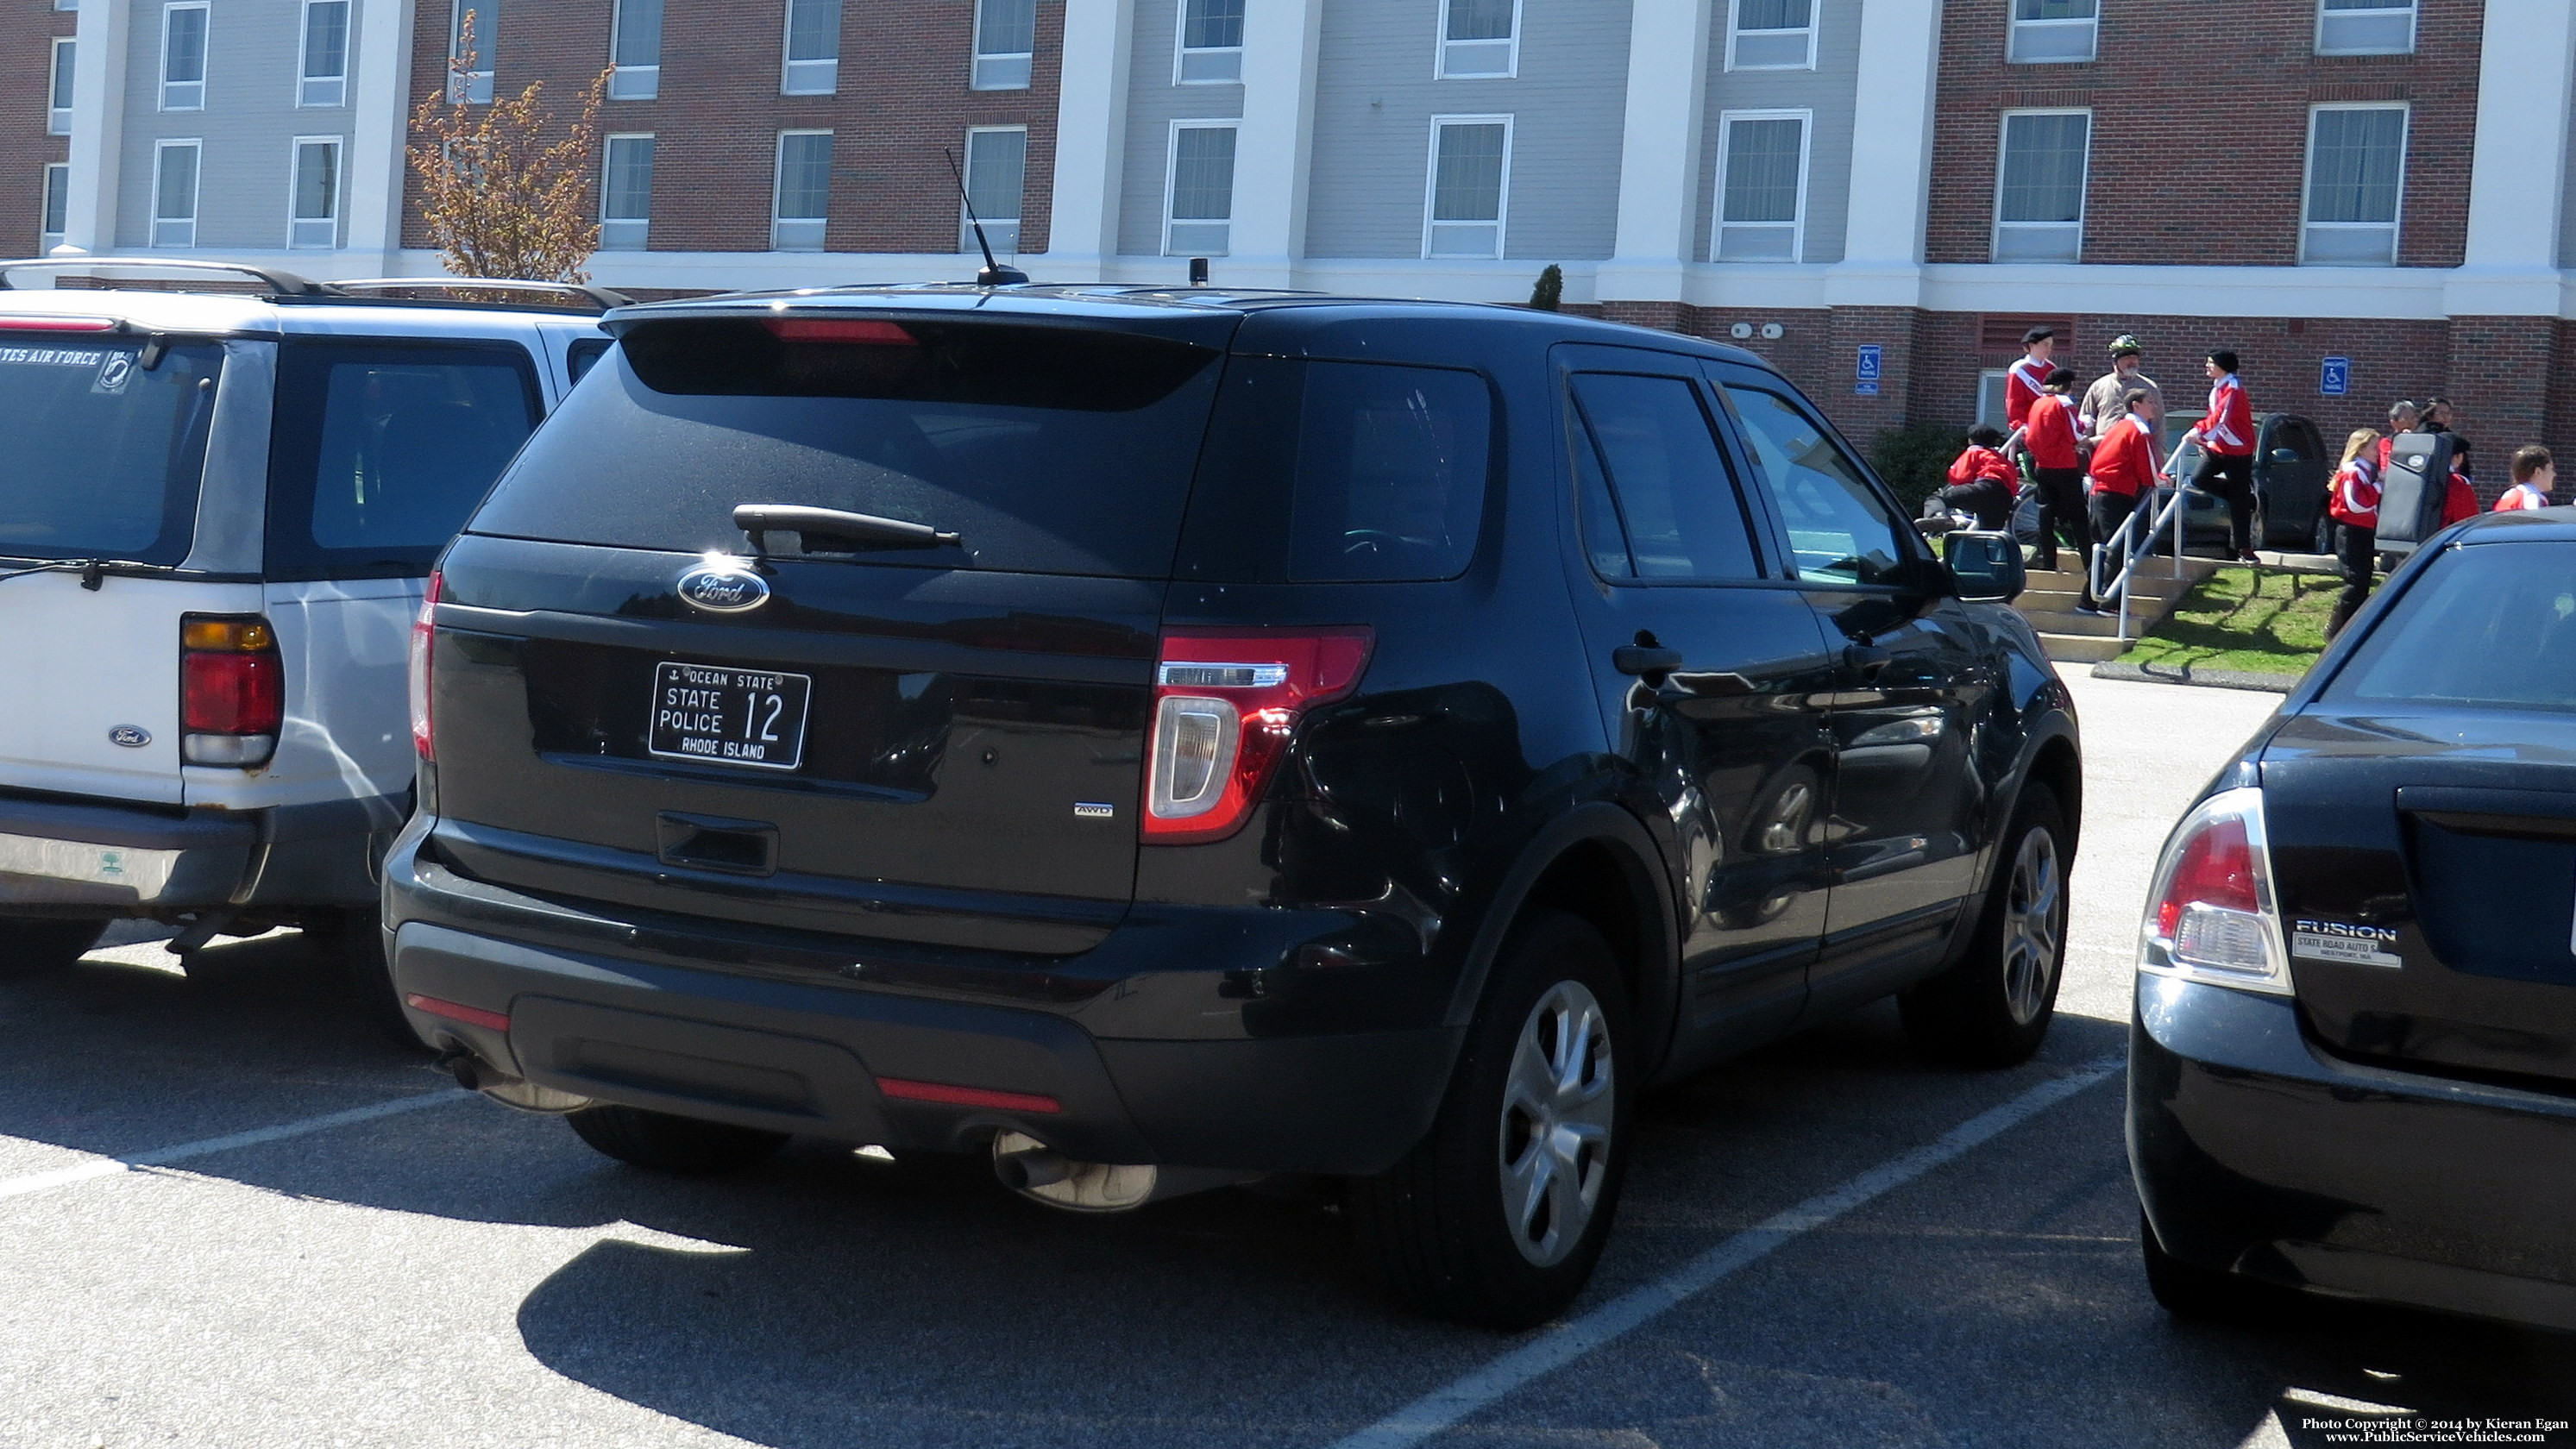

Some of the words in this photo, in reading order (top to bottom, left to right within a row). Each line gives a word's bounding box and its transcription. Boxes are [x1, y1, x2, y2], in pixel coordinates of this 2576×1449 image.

[28, 349, 53, 363] AIR
[54, 350, 101, 366] FORCE
[694, 574, 745, 602] Ford
[689, 670, 728, 686] OCEAN
[737, 674, 775, 690] STATE
[659, 709, 724, 733] POLICE
[667, 687, 721, 710] STATE
[745, 692, 783, 742] 12
[682, 737, 719, 755] RHODE
[723, 741, 765, 760] ISLAND
[2296, 919, 2397, 942] FUSION
[2297, 937, 2322, 948] STATE
[2322, 939, 2345, 950] ROAD
[2347, 941, 2369, 952] AUTO
